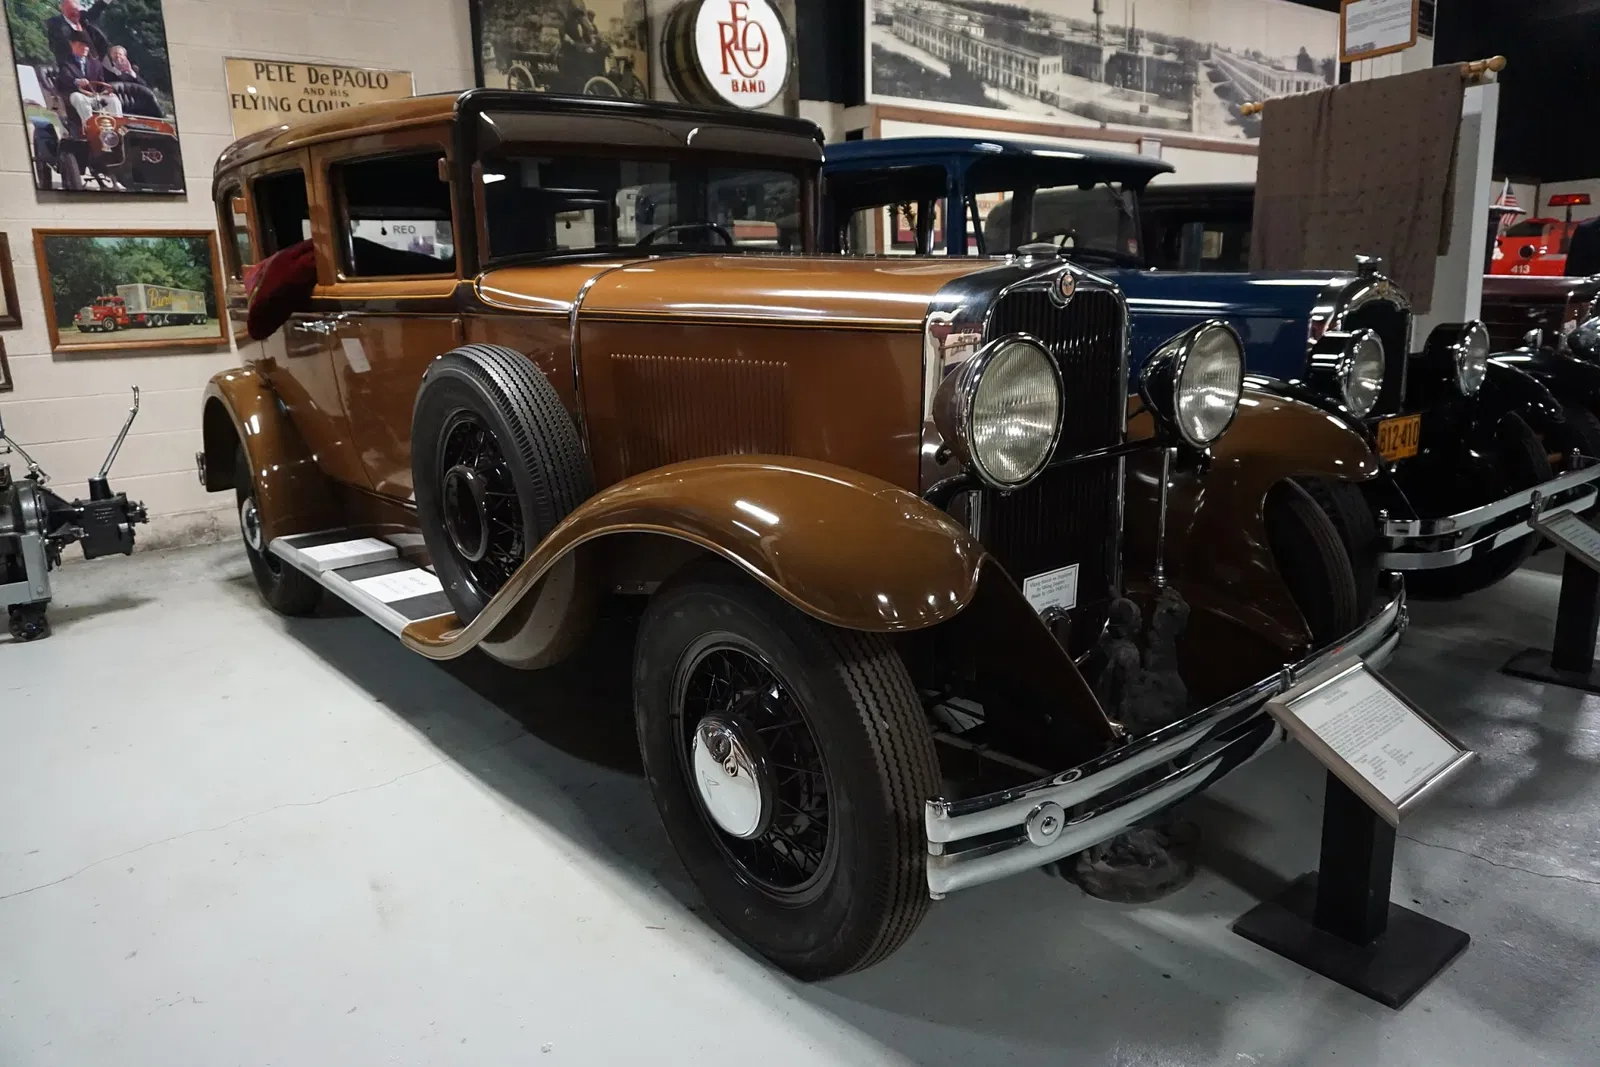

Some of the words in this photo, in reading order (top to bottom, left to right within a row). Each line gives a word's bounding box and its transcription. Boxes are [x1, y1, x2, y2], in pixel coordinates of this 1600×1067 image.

[717, 1, 769, 78] REO
[254, 62, 297, 83] PETE
[303, 87, 325, 97] AND
[330, 90, 350, 98] HIS
[731, 80, 766, 93] BAND
[231, 94, 291, 112] FLYING
[392, 225, 417, 235] REO
[1510, 264, 1530, 274] 413
